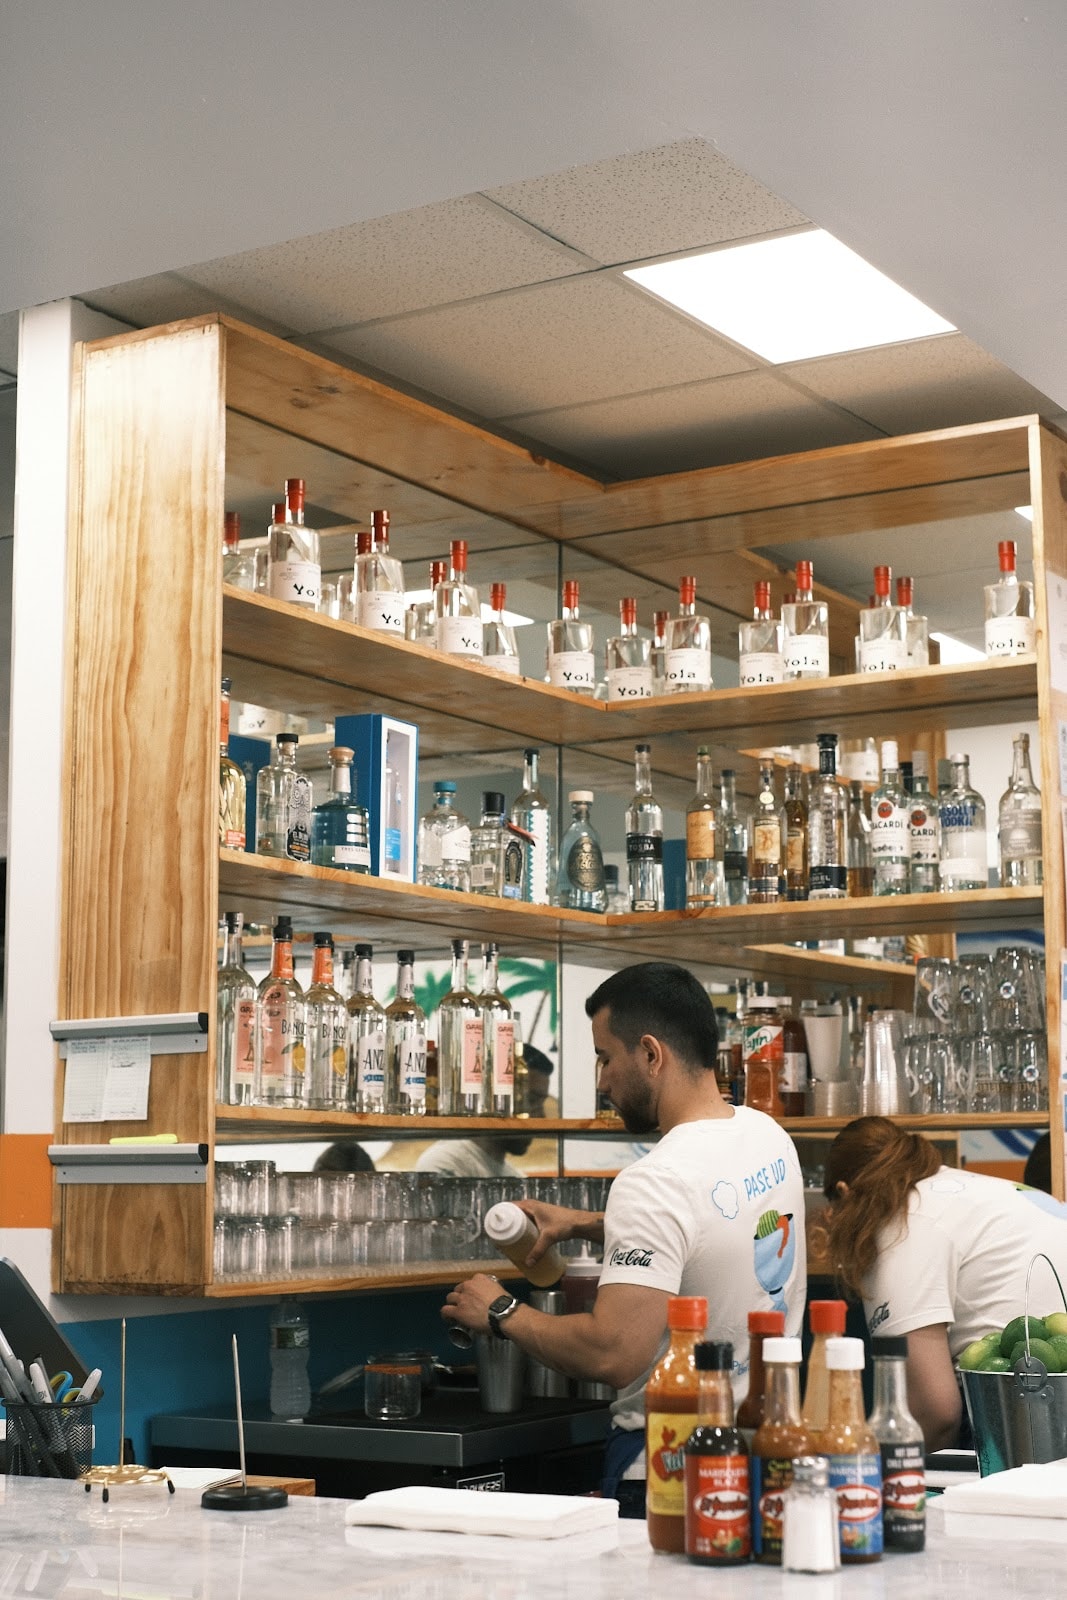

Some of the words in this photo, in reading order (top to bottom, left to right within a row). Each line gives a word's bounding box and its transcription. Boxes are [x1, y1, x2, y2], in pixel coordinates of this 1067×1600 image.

[293, 583, 319, 597] Yo
[743, 1167, 772, 1201] PASE
[771, 1158, 786, 1184] UD
